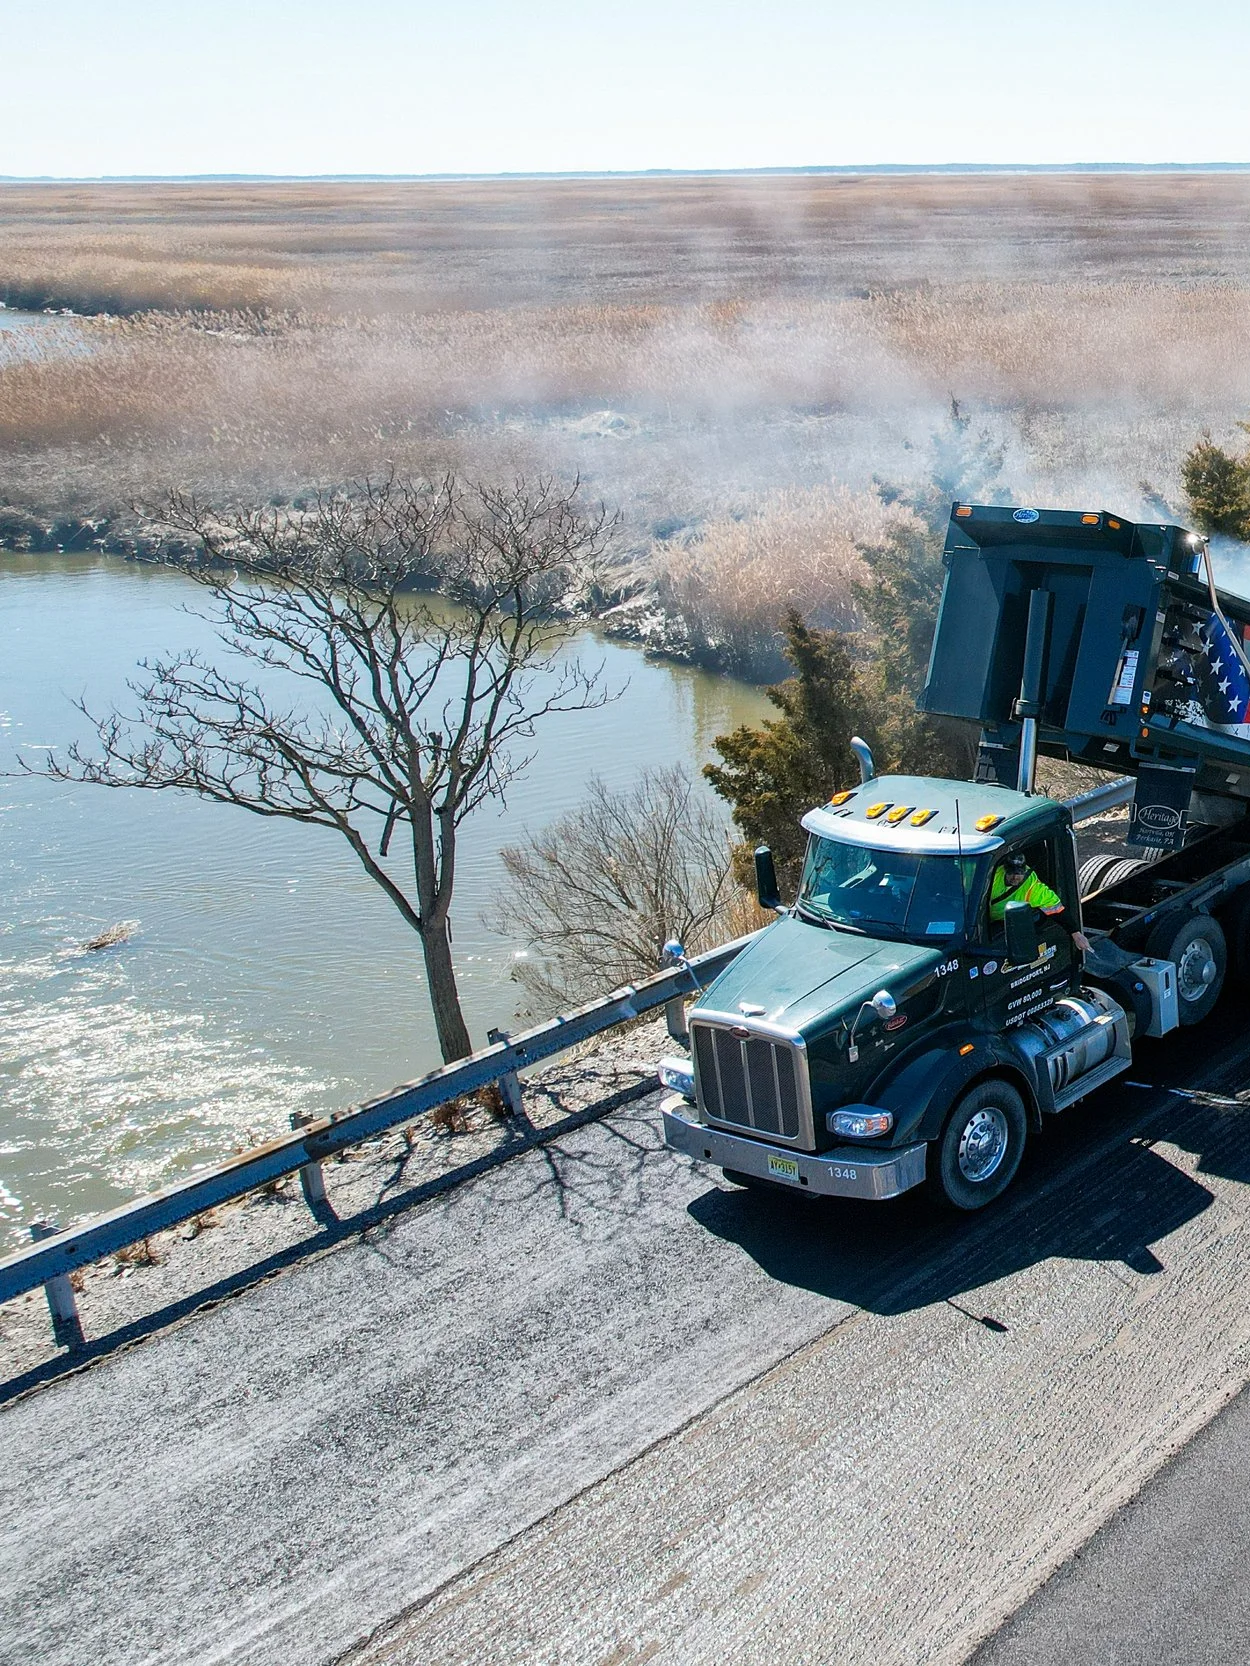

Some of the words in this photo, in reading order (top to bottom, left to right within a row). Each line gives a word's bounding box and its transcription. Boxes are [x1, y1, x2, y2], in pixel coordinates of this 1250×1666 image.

[1140, 808, 1178, 826] Heritage
[934, 959, 959, 978] 1348
[1010, 968, 1043, 989] BRIDGEPORT,
[1043, 964, 1051, 972] NJ
[1007, 998, 1023, 1010] GVW
[1022, 988, 1043, 1002] 80,000
[1005, 1011, 1026, 1026] USDOT
[827, 1166, 857, 1180] 1348
